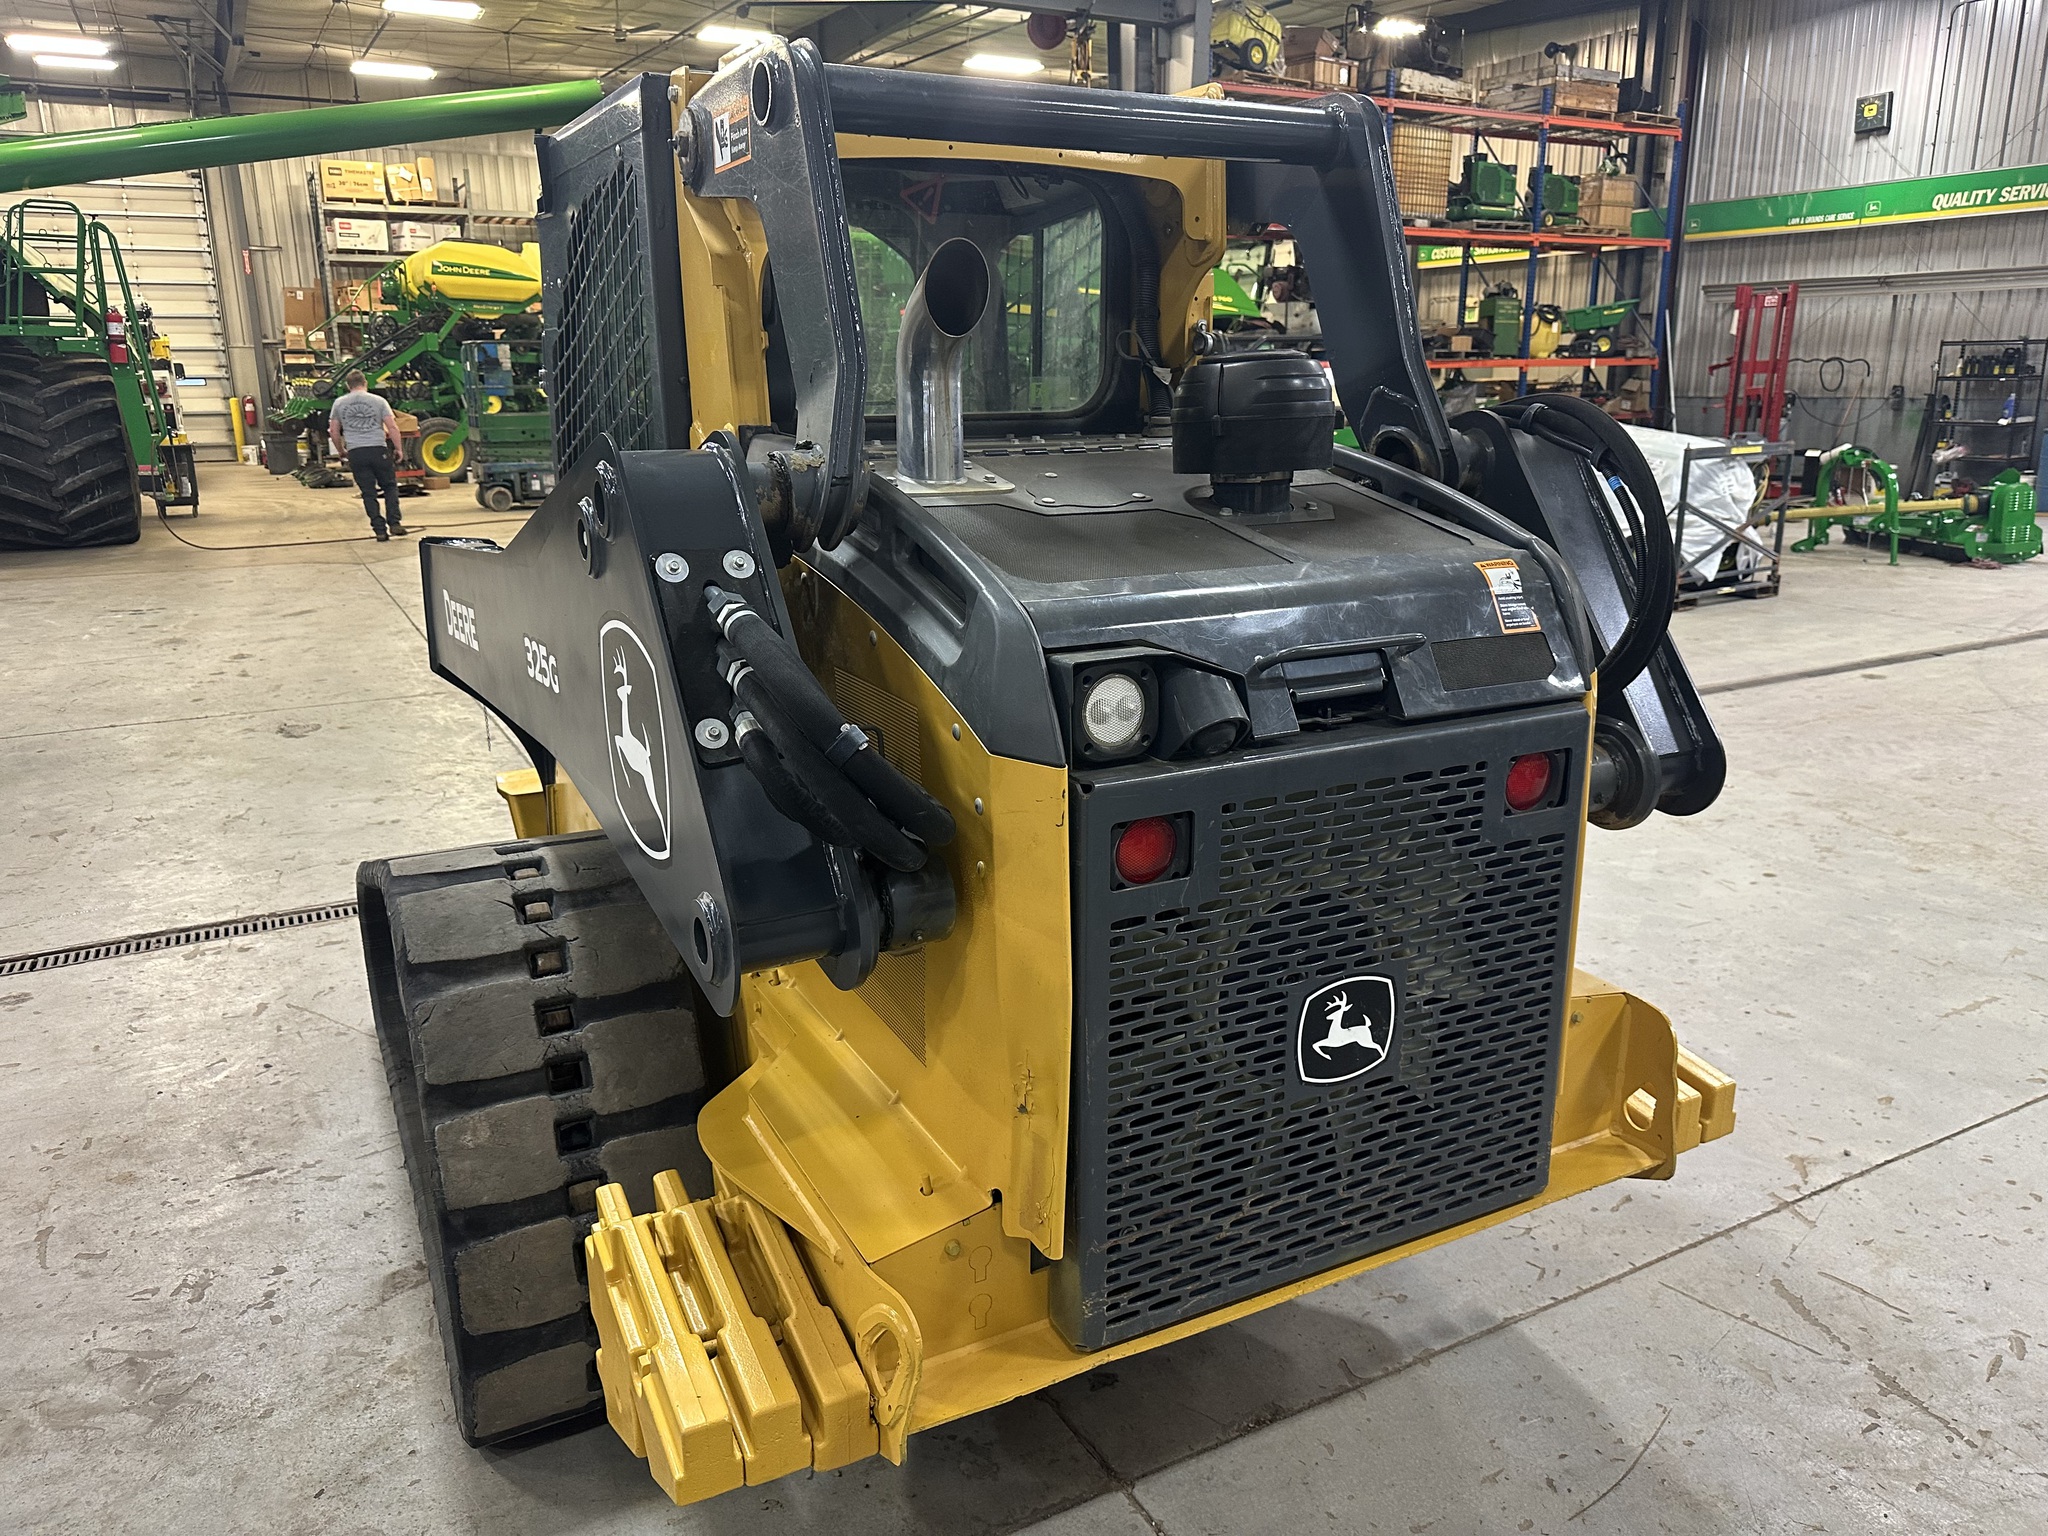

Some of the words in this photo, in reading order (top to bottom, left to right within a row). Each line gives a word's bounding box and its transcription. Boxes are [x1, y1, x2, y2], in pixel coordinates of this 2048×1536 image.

[1932, 188, 1998, 211] QUALITY
[1805, 215, 1824, 224] GROUNDS
[1825, 213, 1837, 222] CARE
[1837, 211, 1855, 221] SERVICE
[1431, 246, 1473, 260] CUSTOM
[437, 263, 462, 273] JOHN
[463, 266, 491, 276] DEERE
[442, 589, 480, 652] DEERE
[523, 636, 560, 694] 325G
